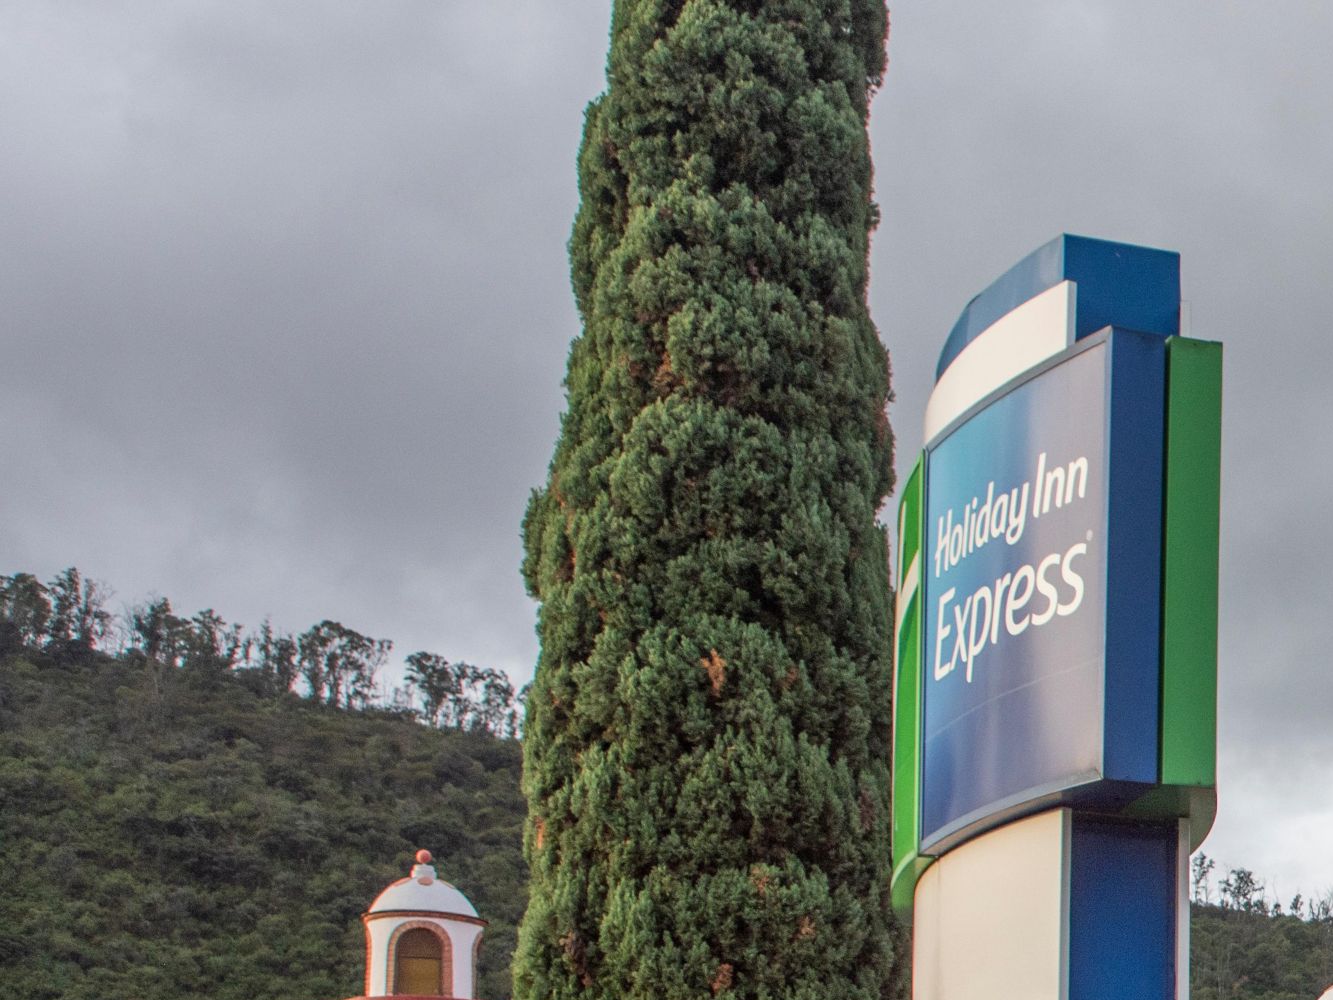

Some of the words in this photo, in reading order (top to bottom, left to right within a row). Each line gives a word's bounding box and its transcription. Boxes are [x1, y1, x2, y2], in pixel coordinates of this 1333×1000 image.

[934, 480, 1030, 578] Holiday
[1032, 452, 1089, 518] Inn
[934, 542, 1087, 683] Express
